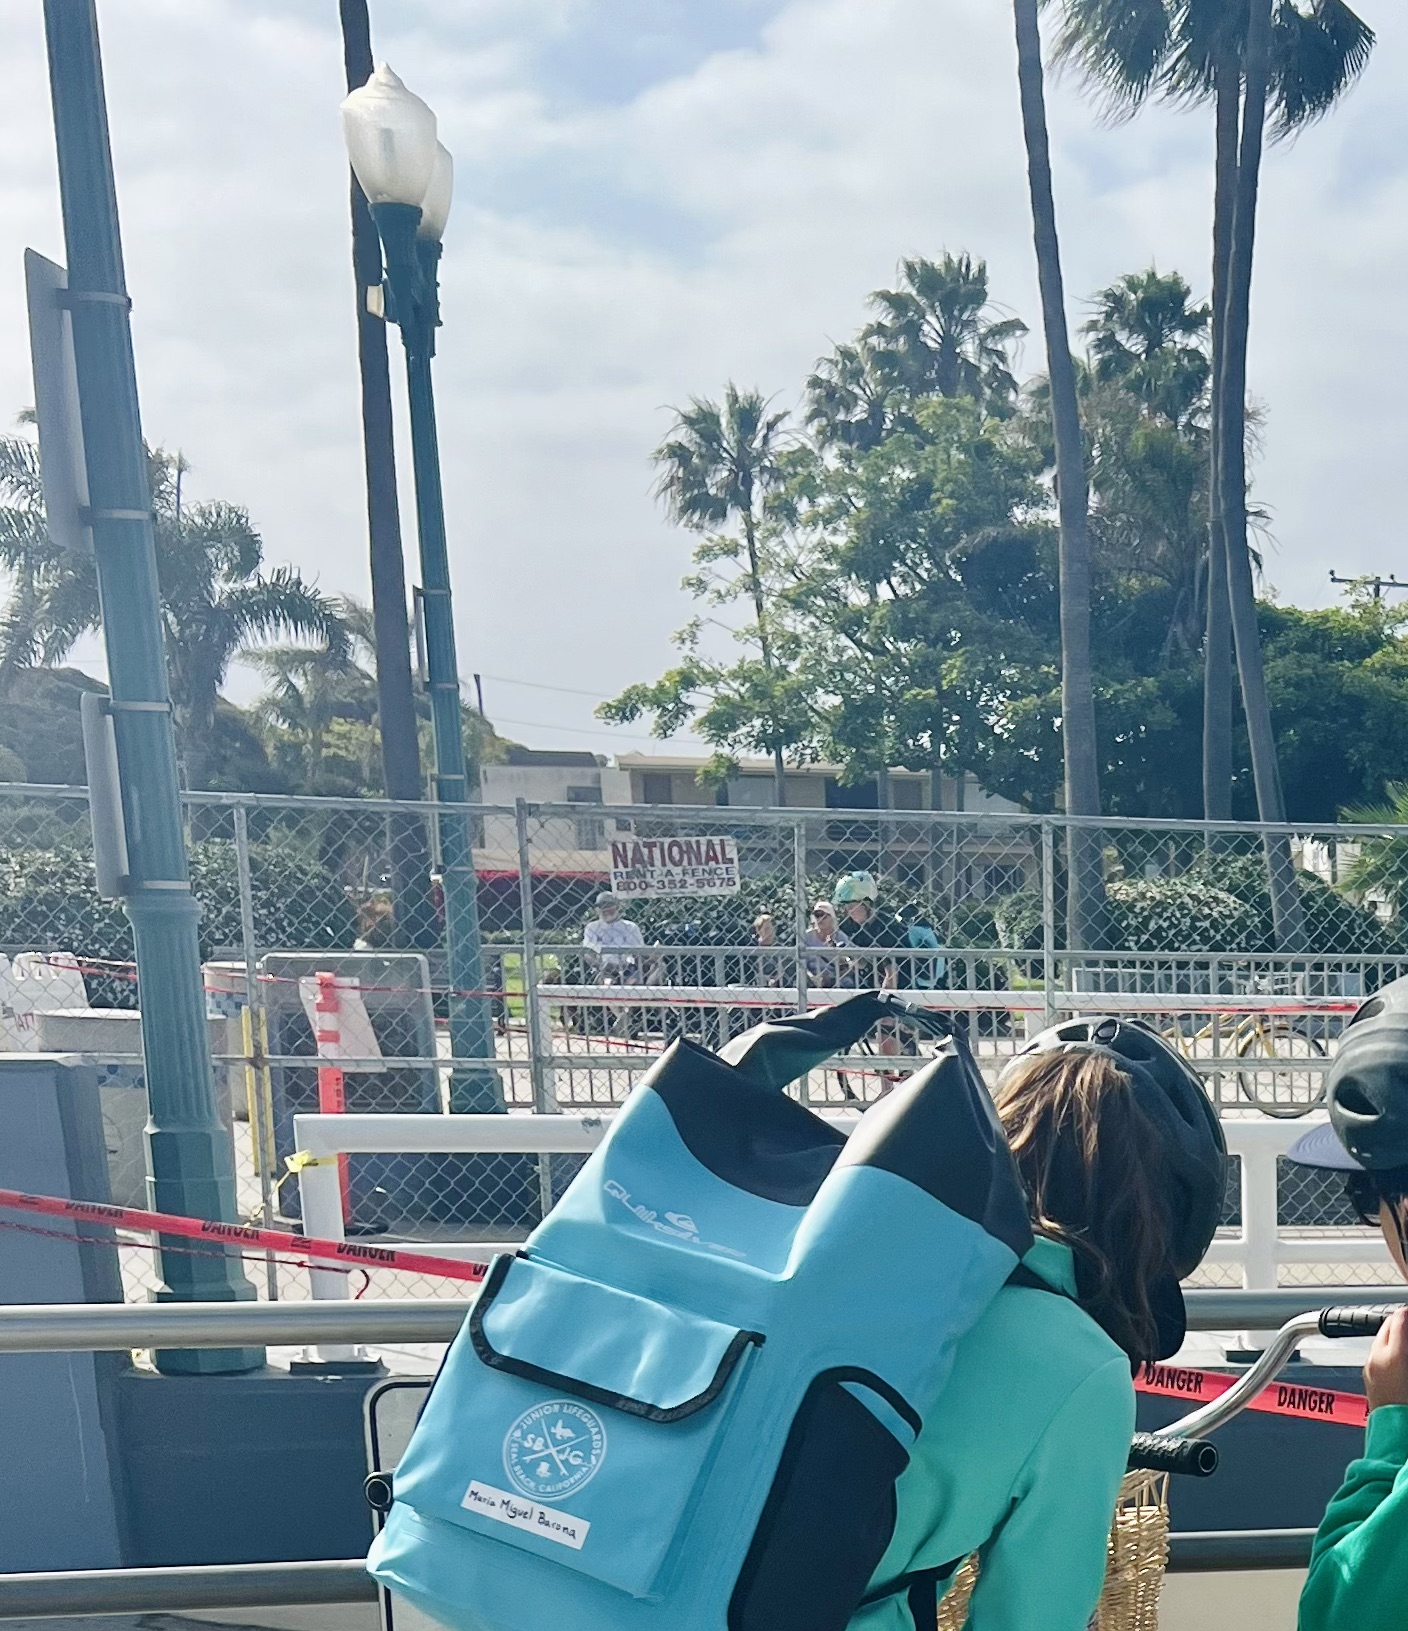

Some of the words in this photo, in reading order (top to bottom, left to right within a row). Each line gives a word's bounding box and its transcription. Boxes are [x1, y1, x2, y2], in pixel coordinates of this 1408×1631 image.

[611, 839, 734, 869] NATIONAL
[613, 866, 736, 881] RENT-A-FENCE
[616, 878, 737, 891] 800-352-5675
[1146, 1365, 1203, 1394] DANGER
[1277, 1386, 1335, 1415] DANGER
[520, 1404, 560, 1430] JUNIOR
[523, 1433, 546, 1451] SB
[500, 1499, 534, 1520] Miguel
